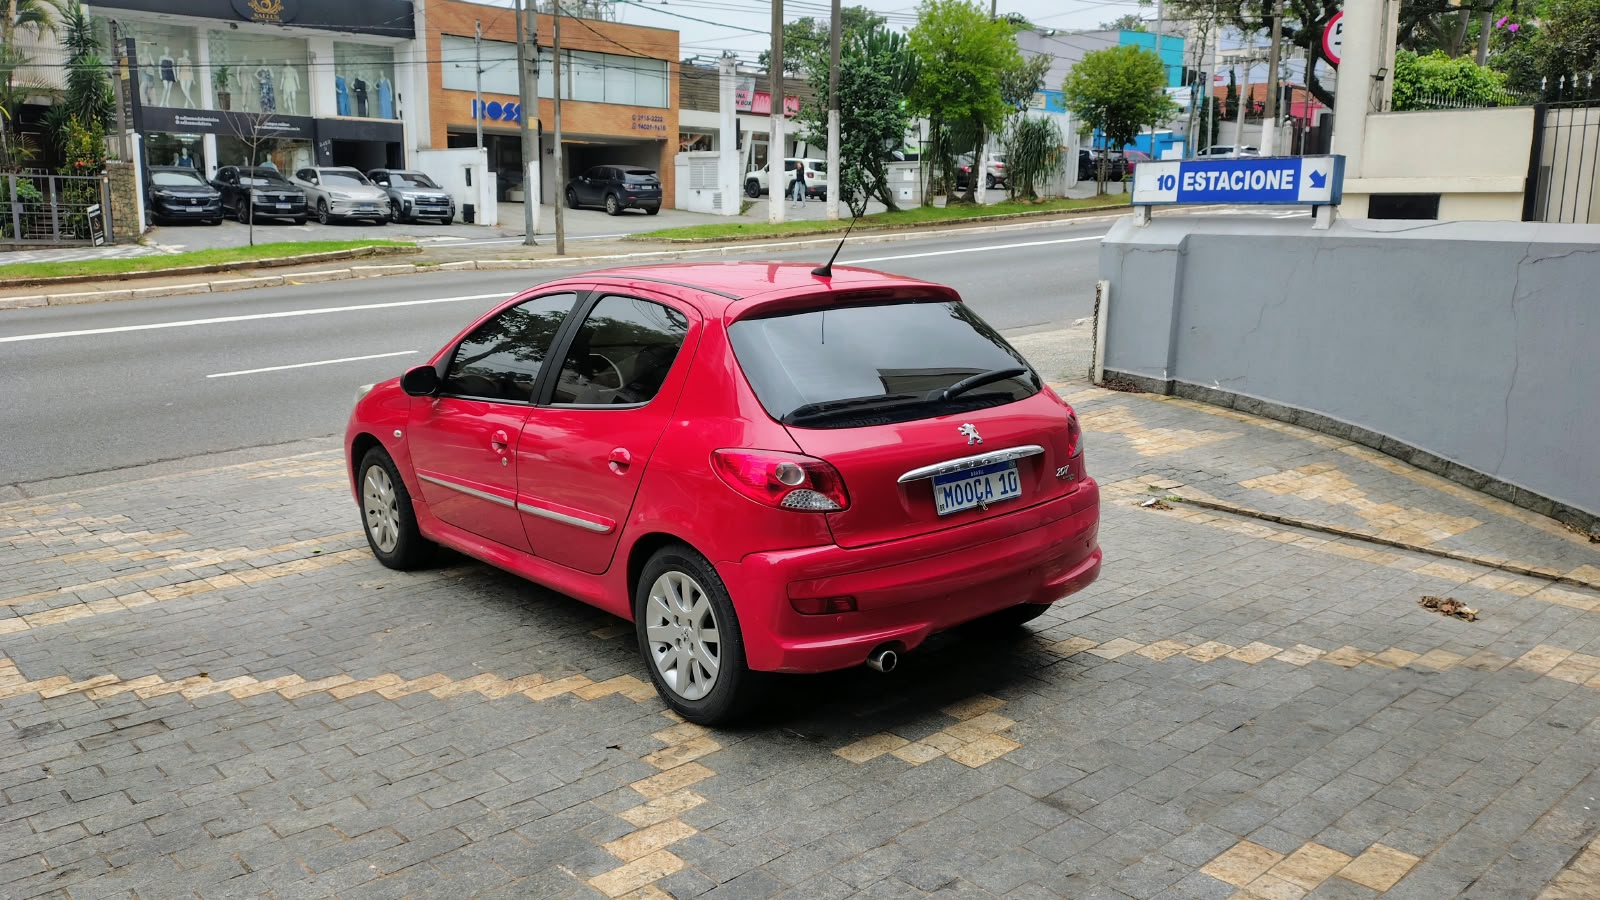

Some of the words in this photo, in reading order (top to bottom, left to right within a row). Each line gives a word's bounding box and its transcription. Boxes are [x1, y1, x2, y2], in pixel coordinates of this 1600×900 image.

[1156, 174, 1176, 191] 10
[1182, 169, 1295, 191] ESTACIONE
[1056, 464, 1070, 477] 207
[943, 477, 994, 508] MOOCA
[999, 471, 1018, 495] 10
